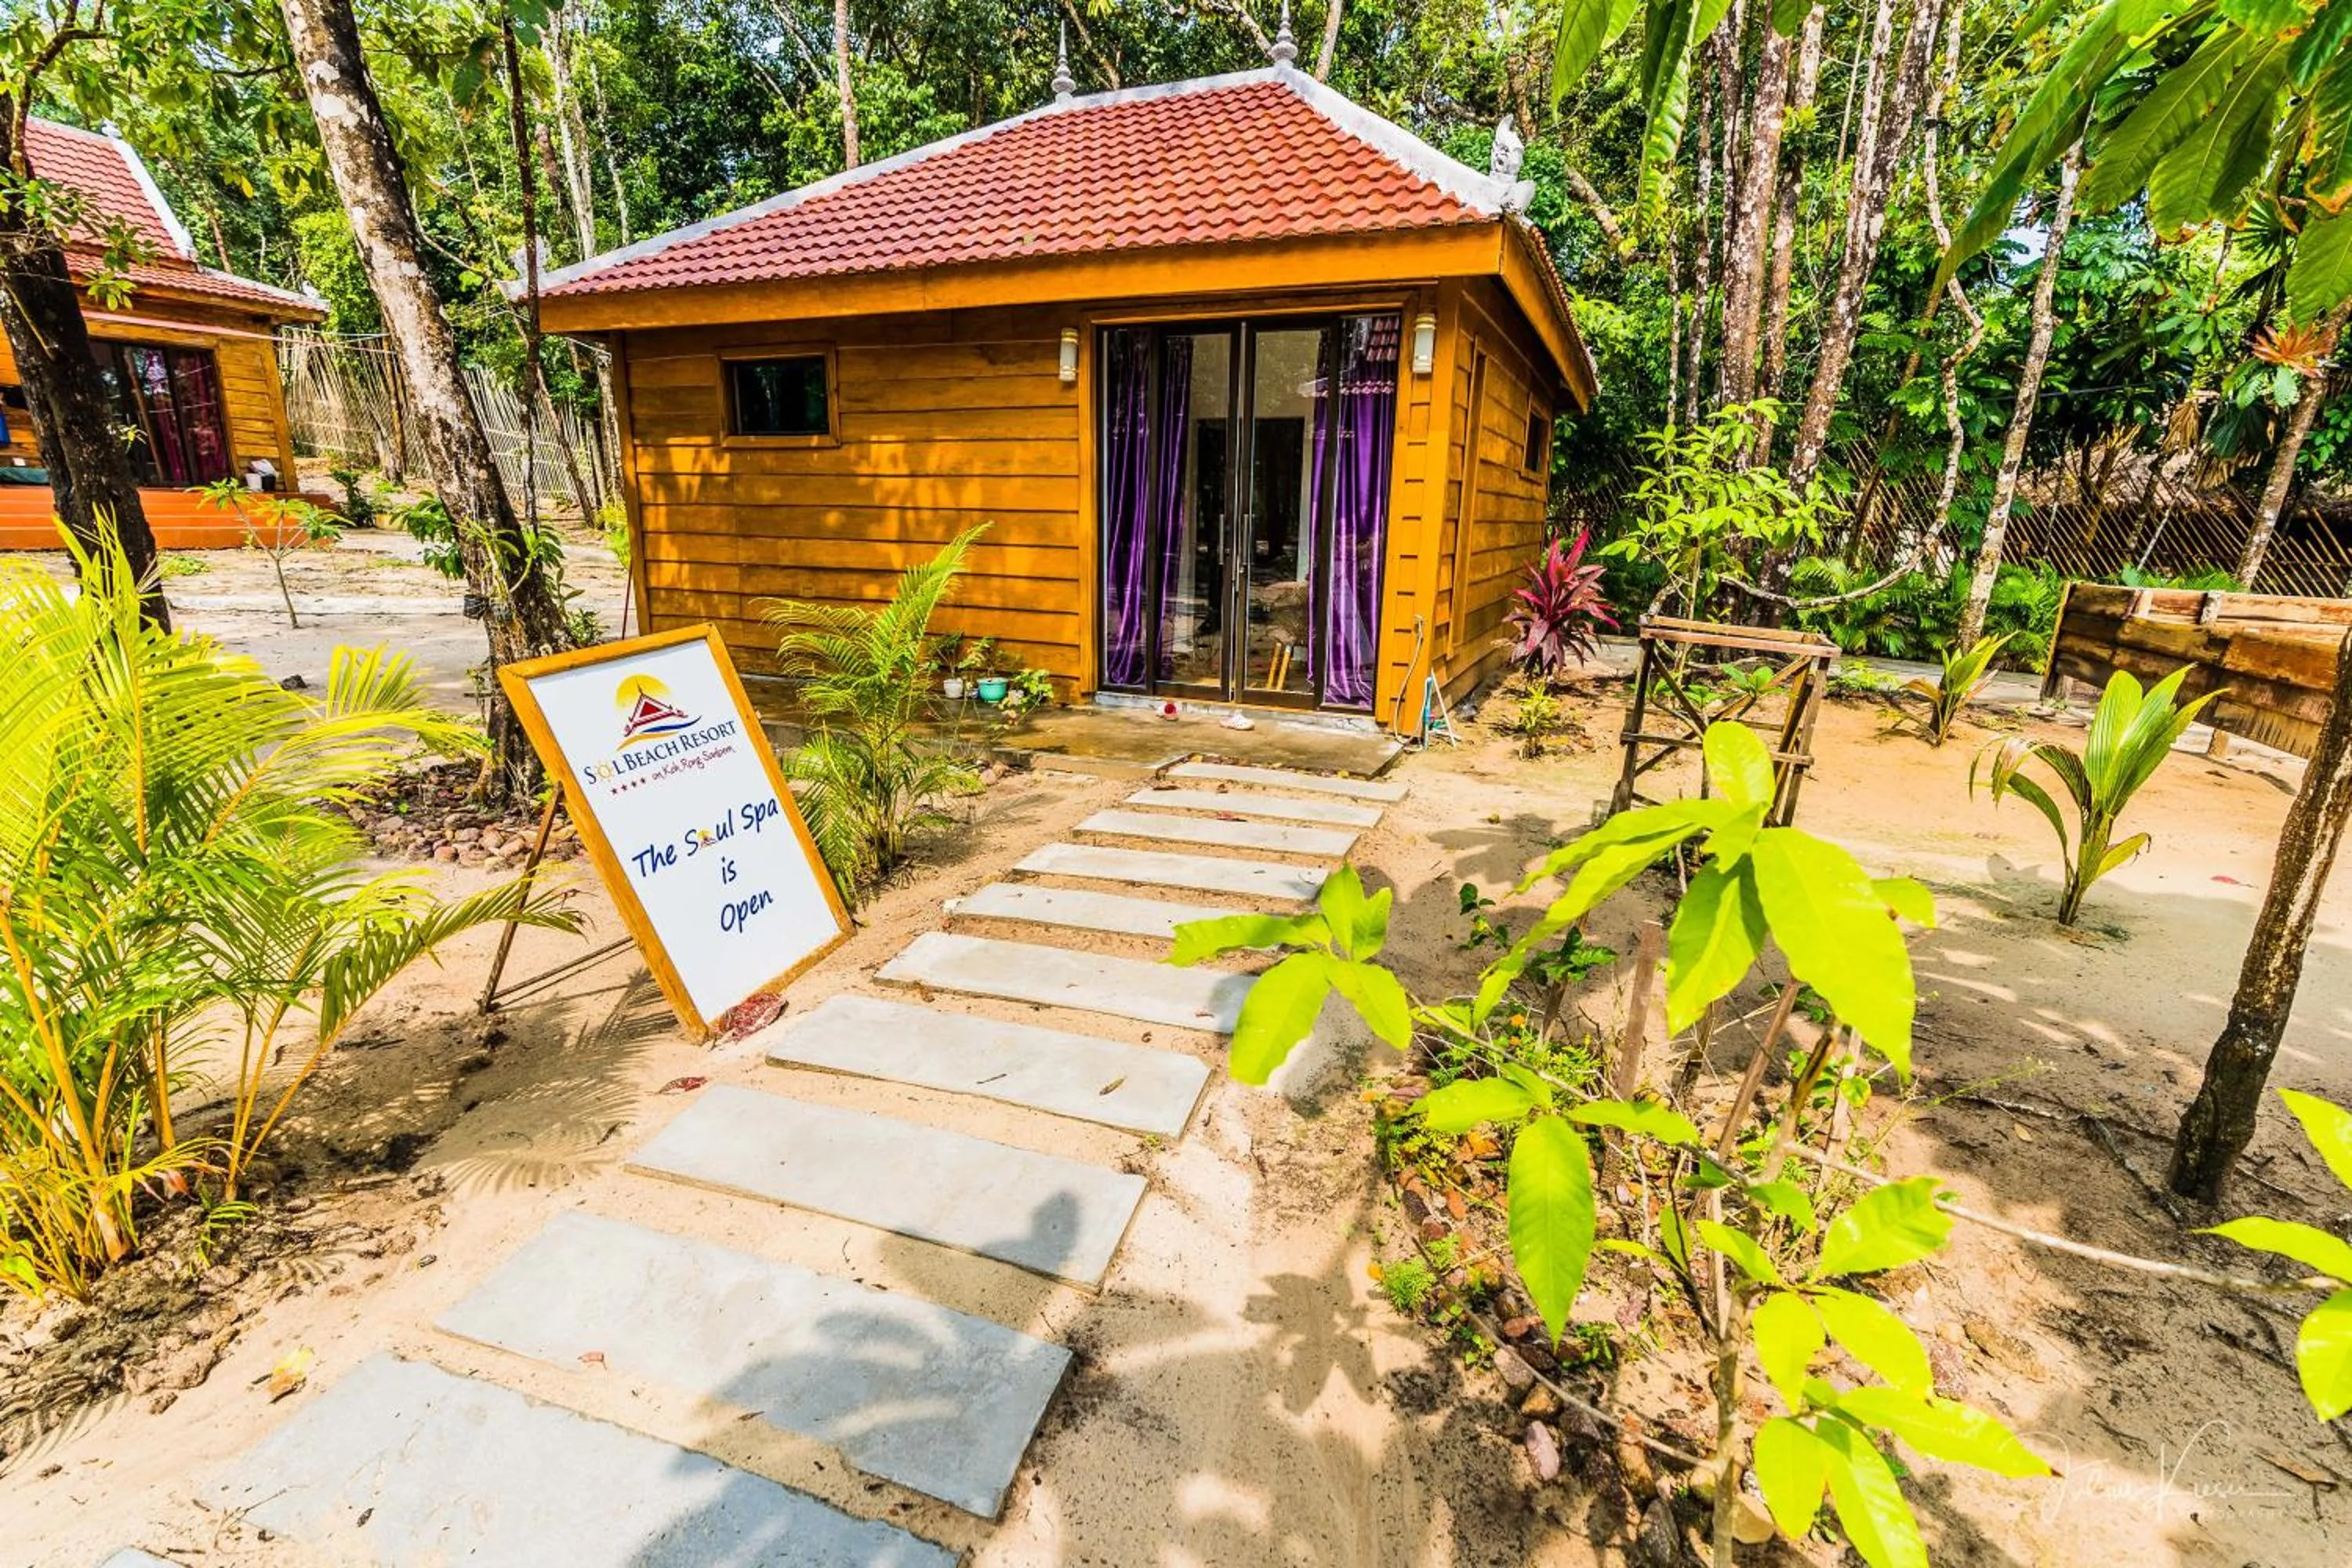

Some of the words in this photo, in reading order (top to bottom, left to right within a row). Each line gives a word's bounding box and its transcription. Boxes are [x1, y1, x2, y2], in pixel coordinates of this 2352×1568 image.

[623, 740, 680, 770] BEACH
[680, 720, 737, 751] RESORT
[632, 844, 677, 877] The
[741, 798, 779, 833] Spa
[722, 856, 737, 884] is
[720, 890, 773, 933] Open
